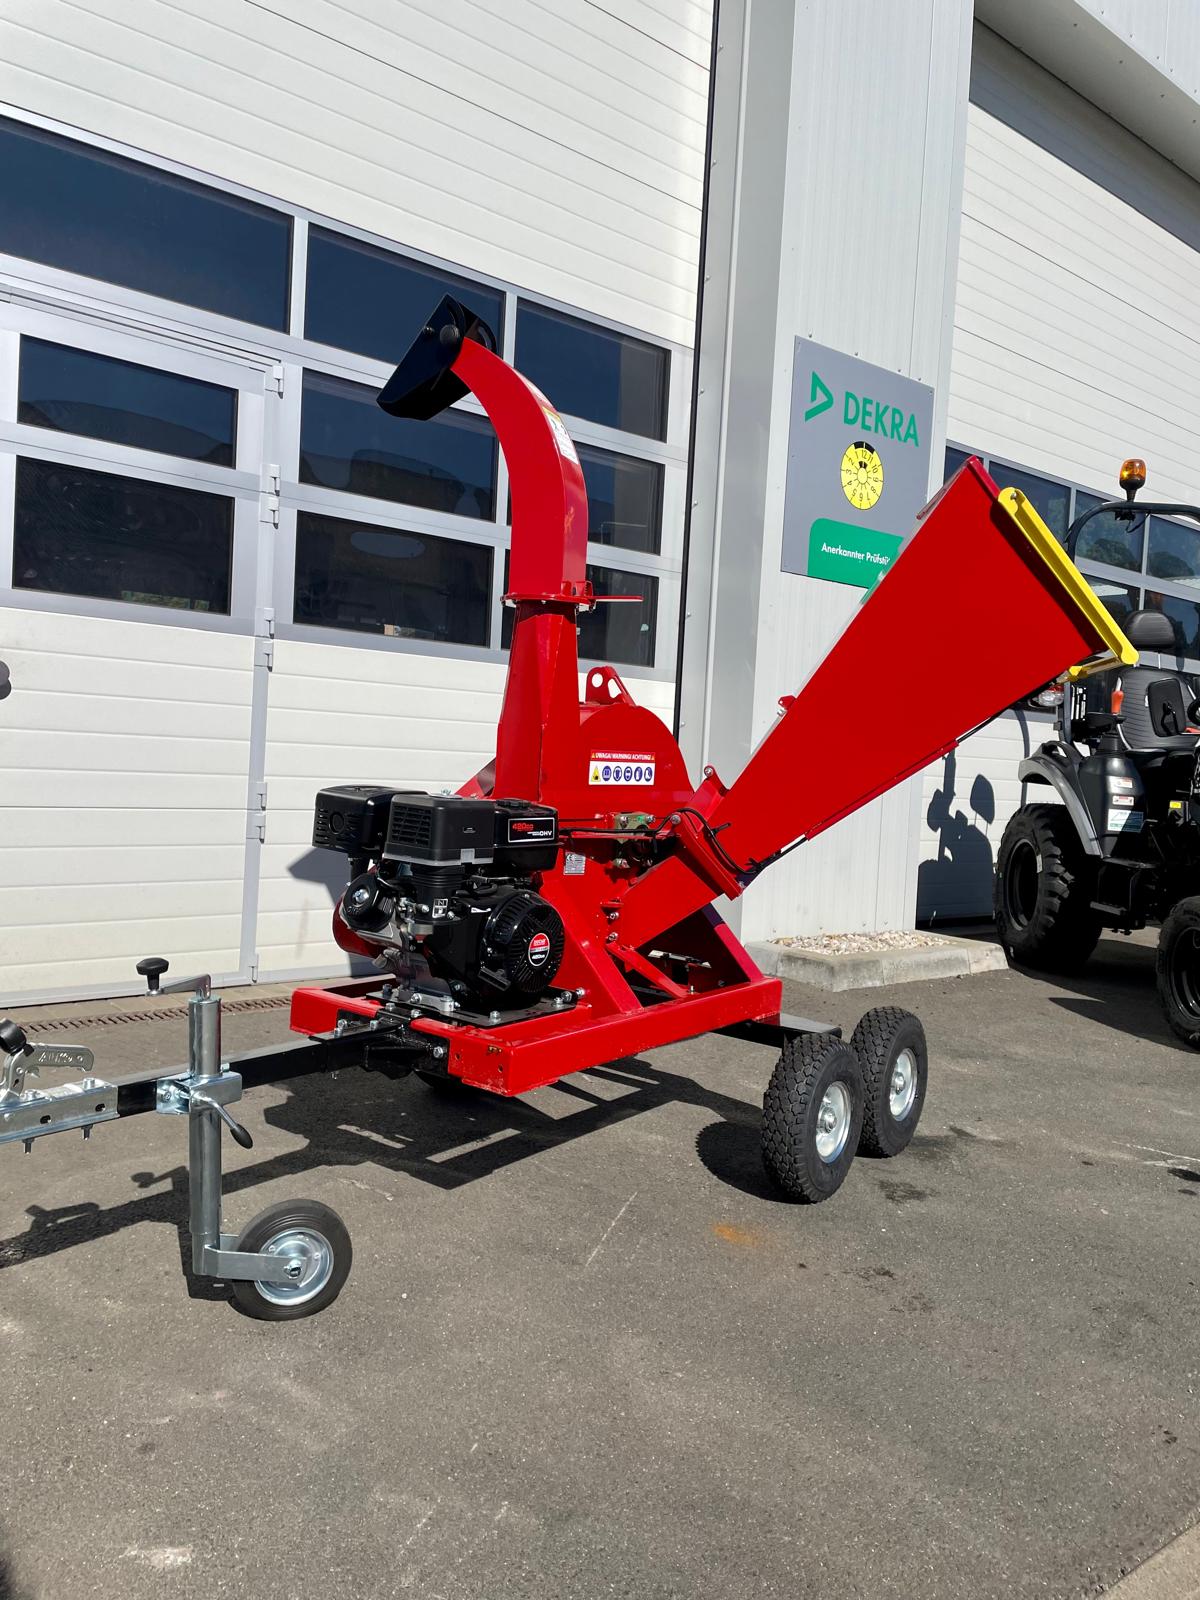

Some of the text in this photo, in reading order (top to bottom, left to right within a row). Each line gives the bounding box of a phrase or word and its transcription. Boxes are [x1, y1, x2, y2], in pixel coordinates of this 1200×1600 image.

[843, 390, 920, 448] DEKRA
[848, 456, 855, 466] 2
[861, 449, 868, 460] 12
[867, 454, 874, 465] 11
[845, 468, 853, 476] 3
[871, 463, 879, 475] 10
[852, 488, 858, 497] 5
[870, 485, 877, 494] 8
[821, 542, 865, 561] Anerkannter
